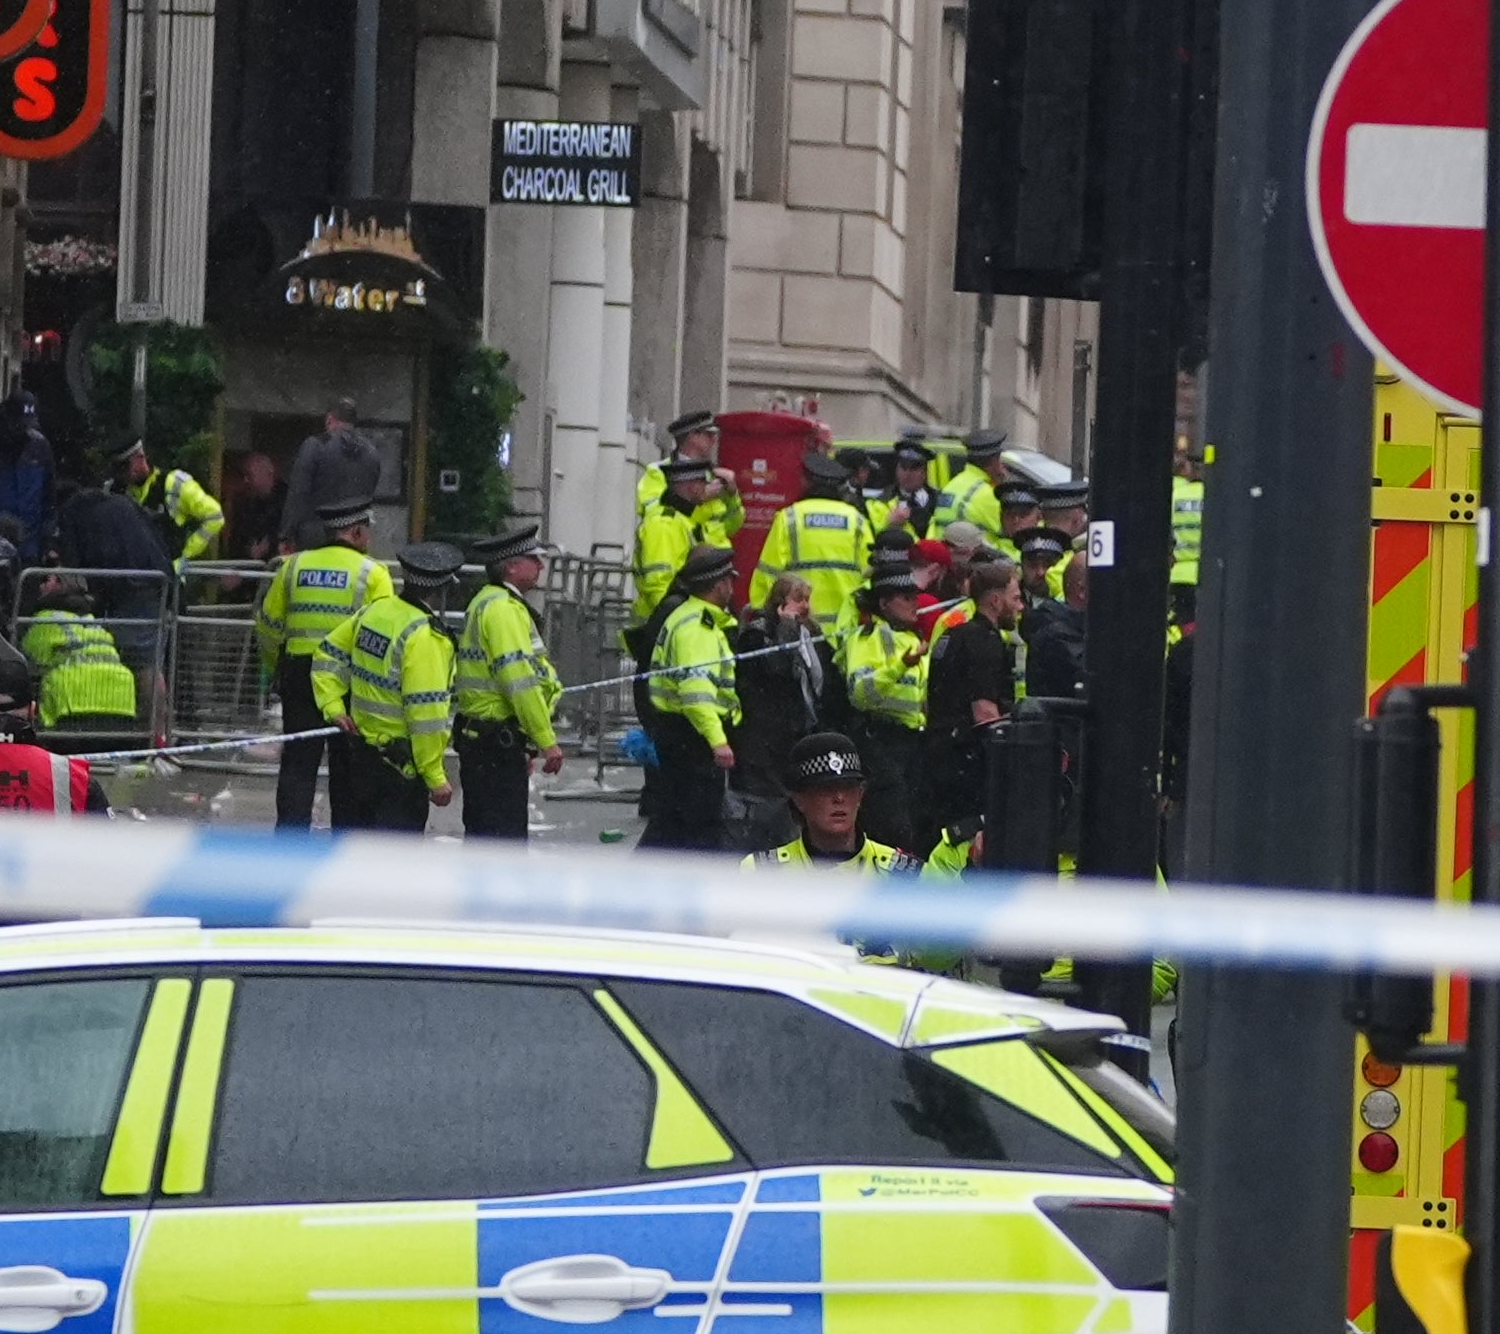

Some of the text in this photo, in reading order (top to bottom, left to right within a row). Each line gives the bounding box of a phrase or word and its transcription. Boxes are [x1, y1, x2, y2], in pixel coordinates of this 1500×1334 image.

[503, 121, 632, 157] MEDITERRANEAN
[502, 166, 631, 204] CHARCOAL GRILL
[285, 275, 305, 305] 8
[309, 277, 400, 312] Water
[300, 570, 345, 586] POLICE
